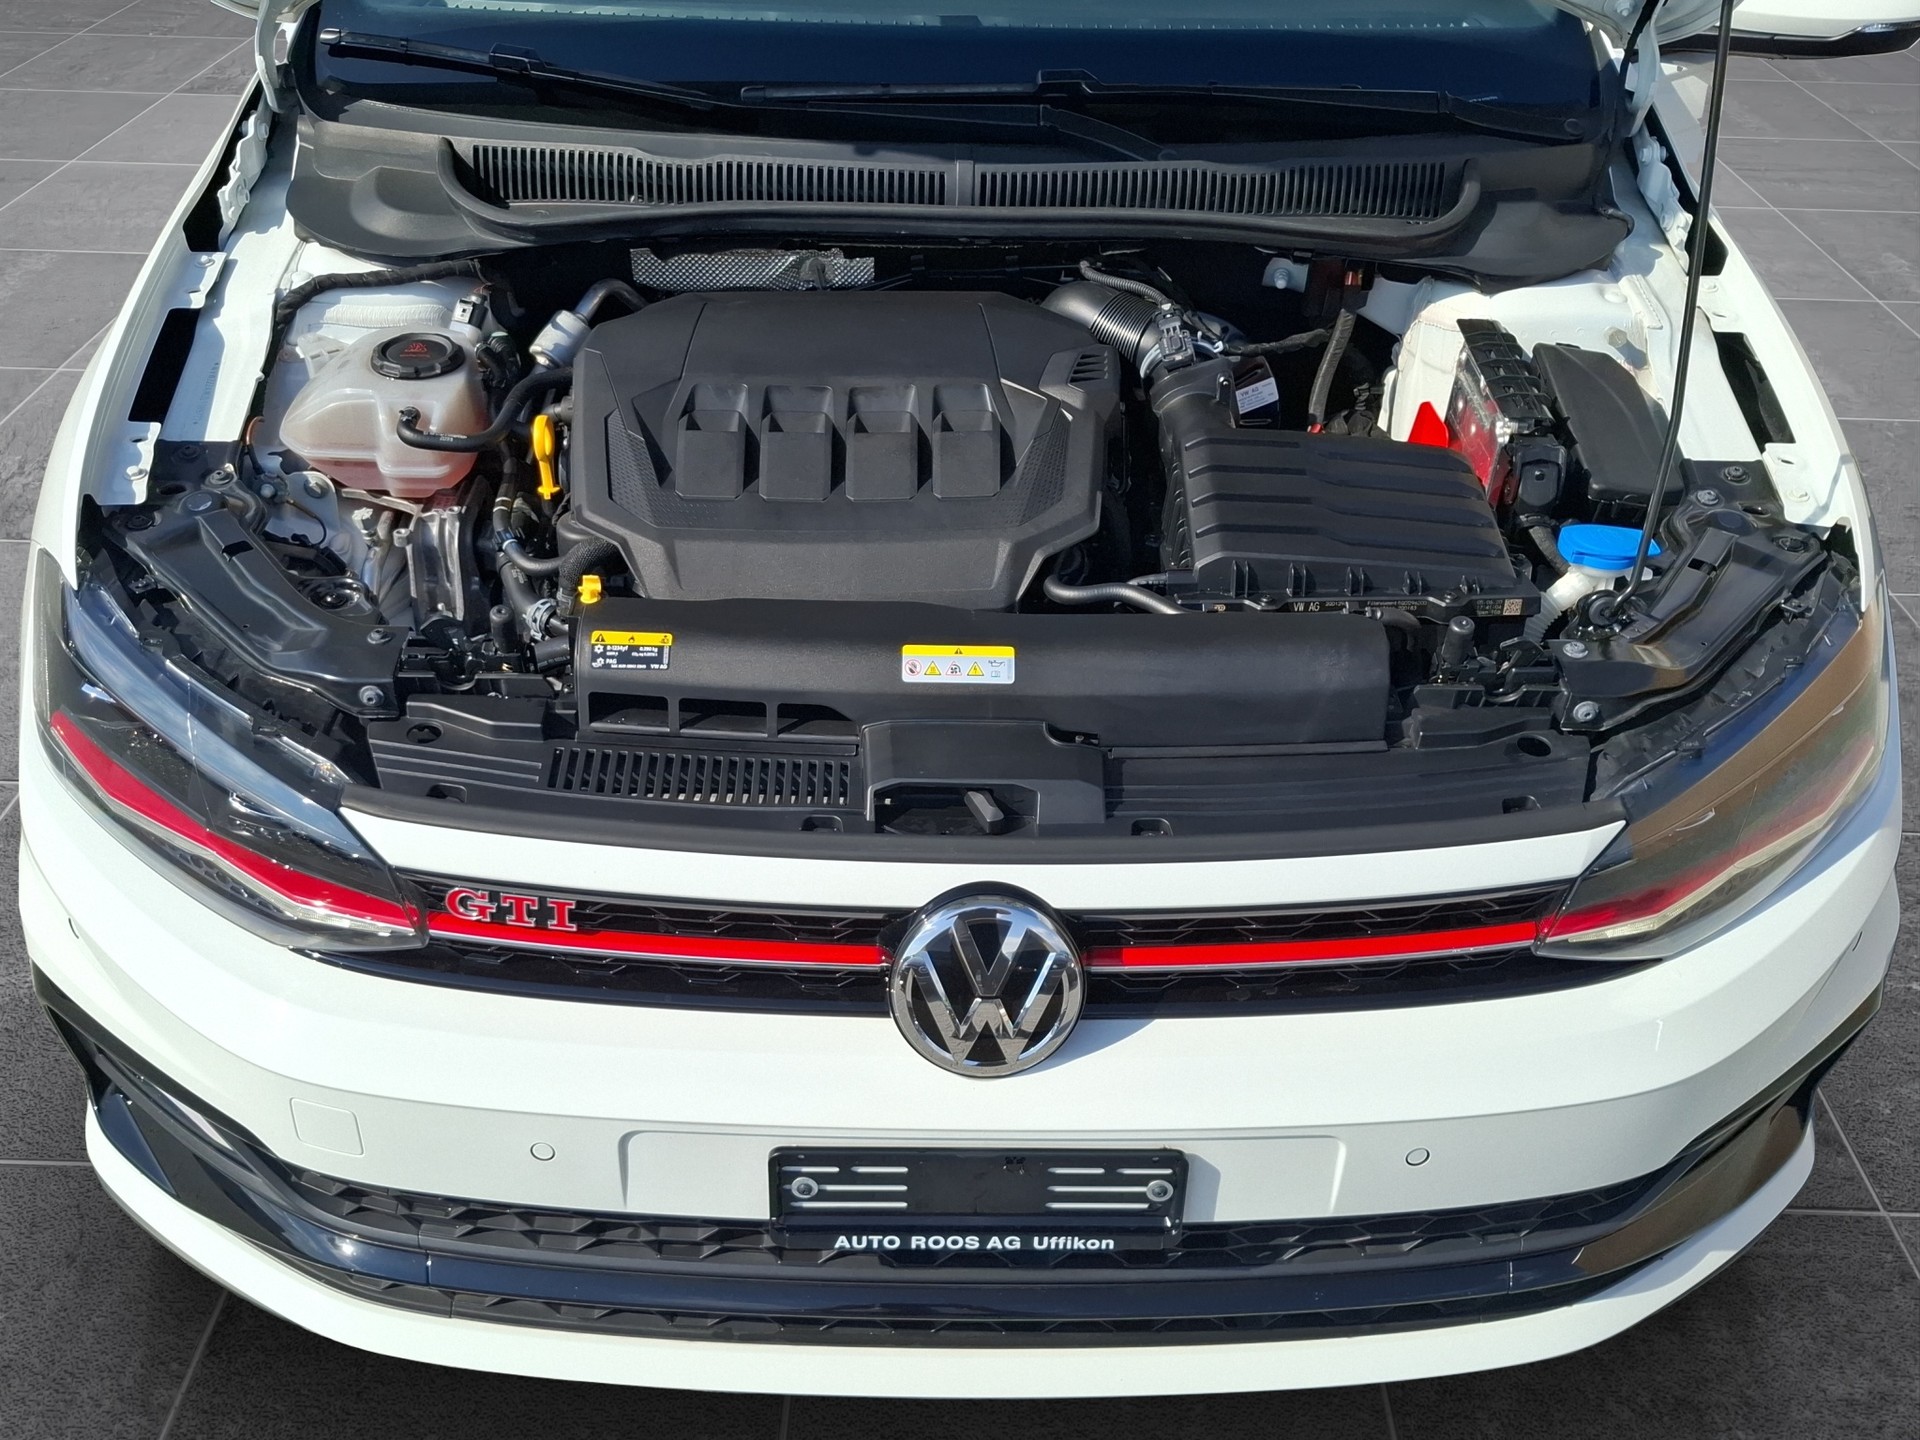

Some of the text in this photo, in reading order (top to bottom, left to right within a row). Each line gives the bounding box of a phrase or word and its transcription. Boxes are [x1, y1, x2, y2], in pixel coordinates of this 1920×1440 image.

[1293, 602, 1320, 612] VW AG
[445, 887, 577, 931] GTI
[898, 902, 1077, 1070] VW
[834, 1235, 1115, 1250] AUTO ROOS AG Uffikon
